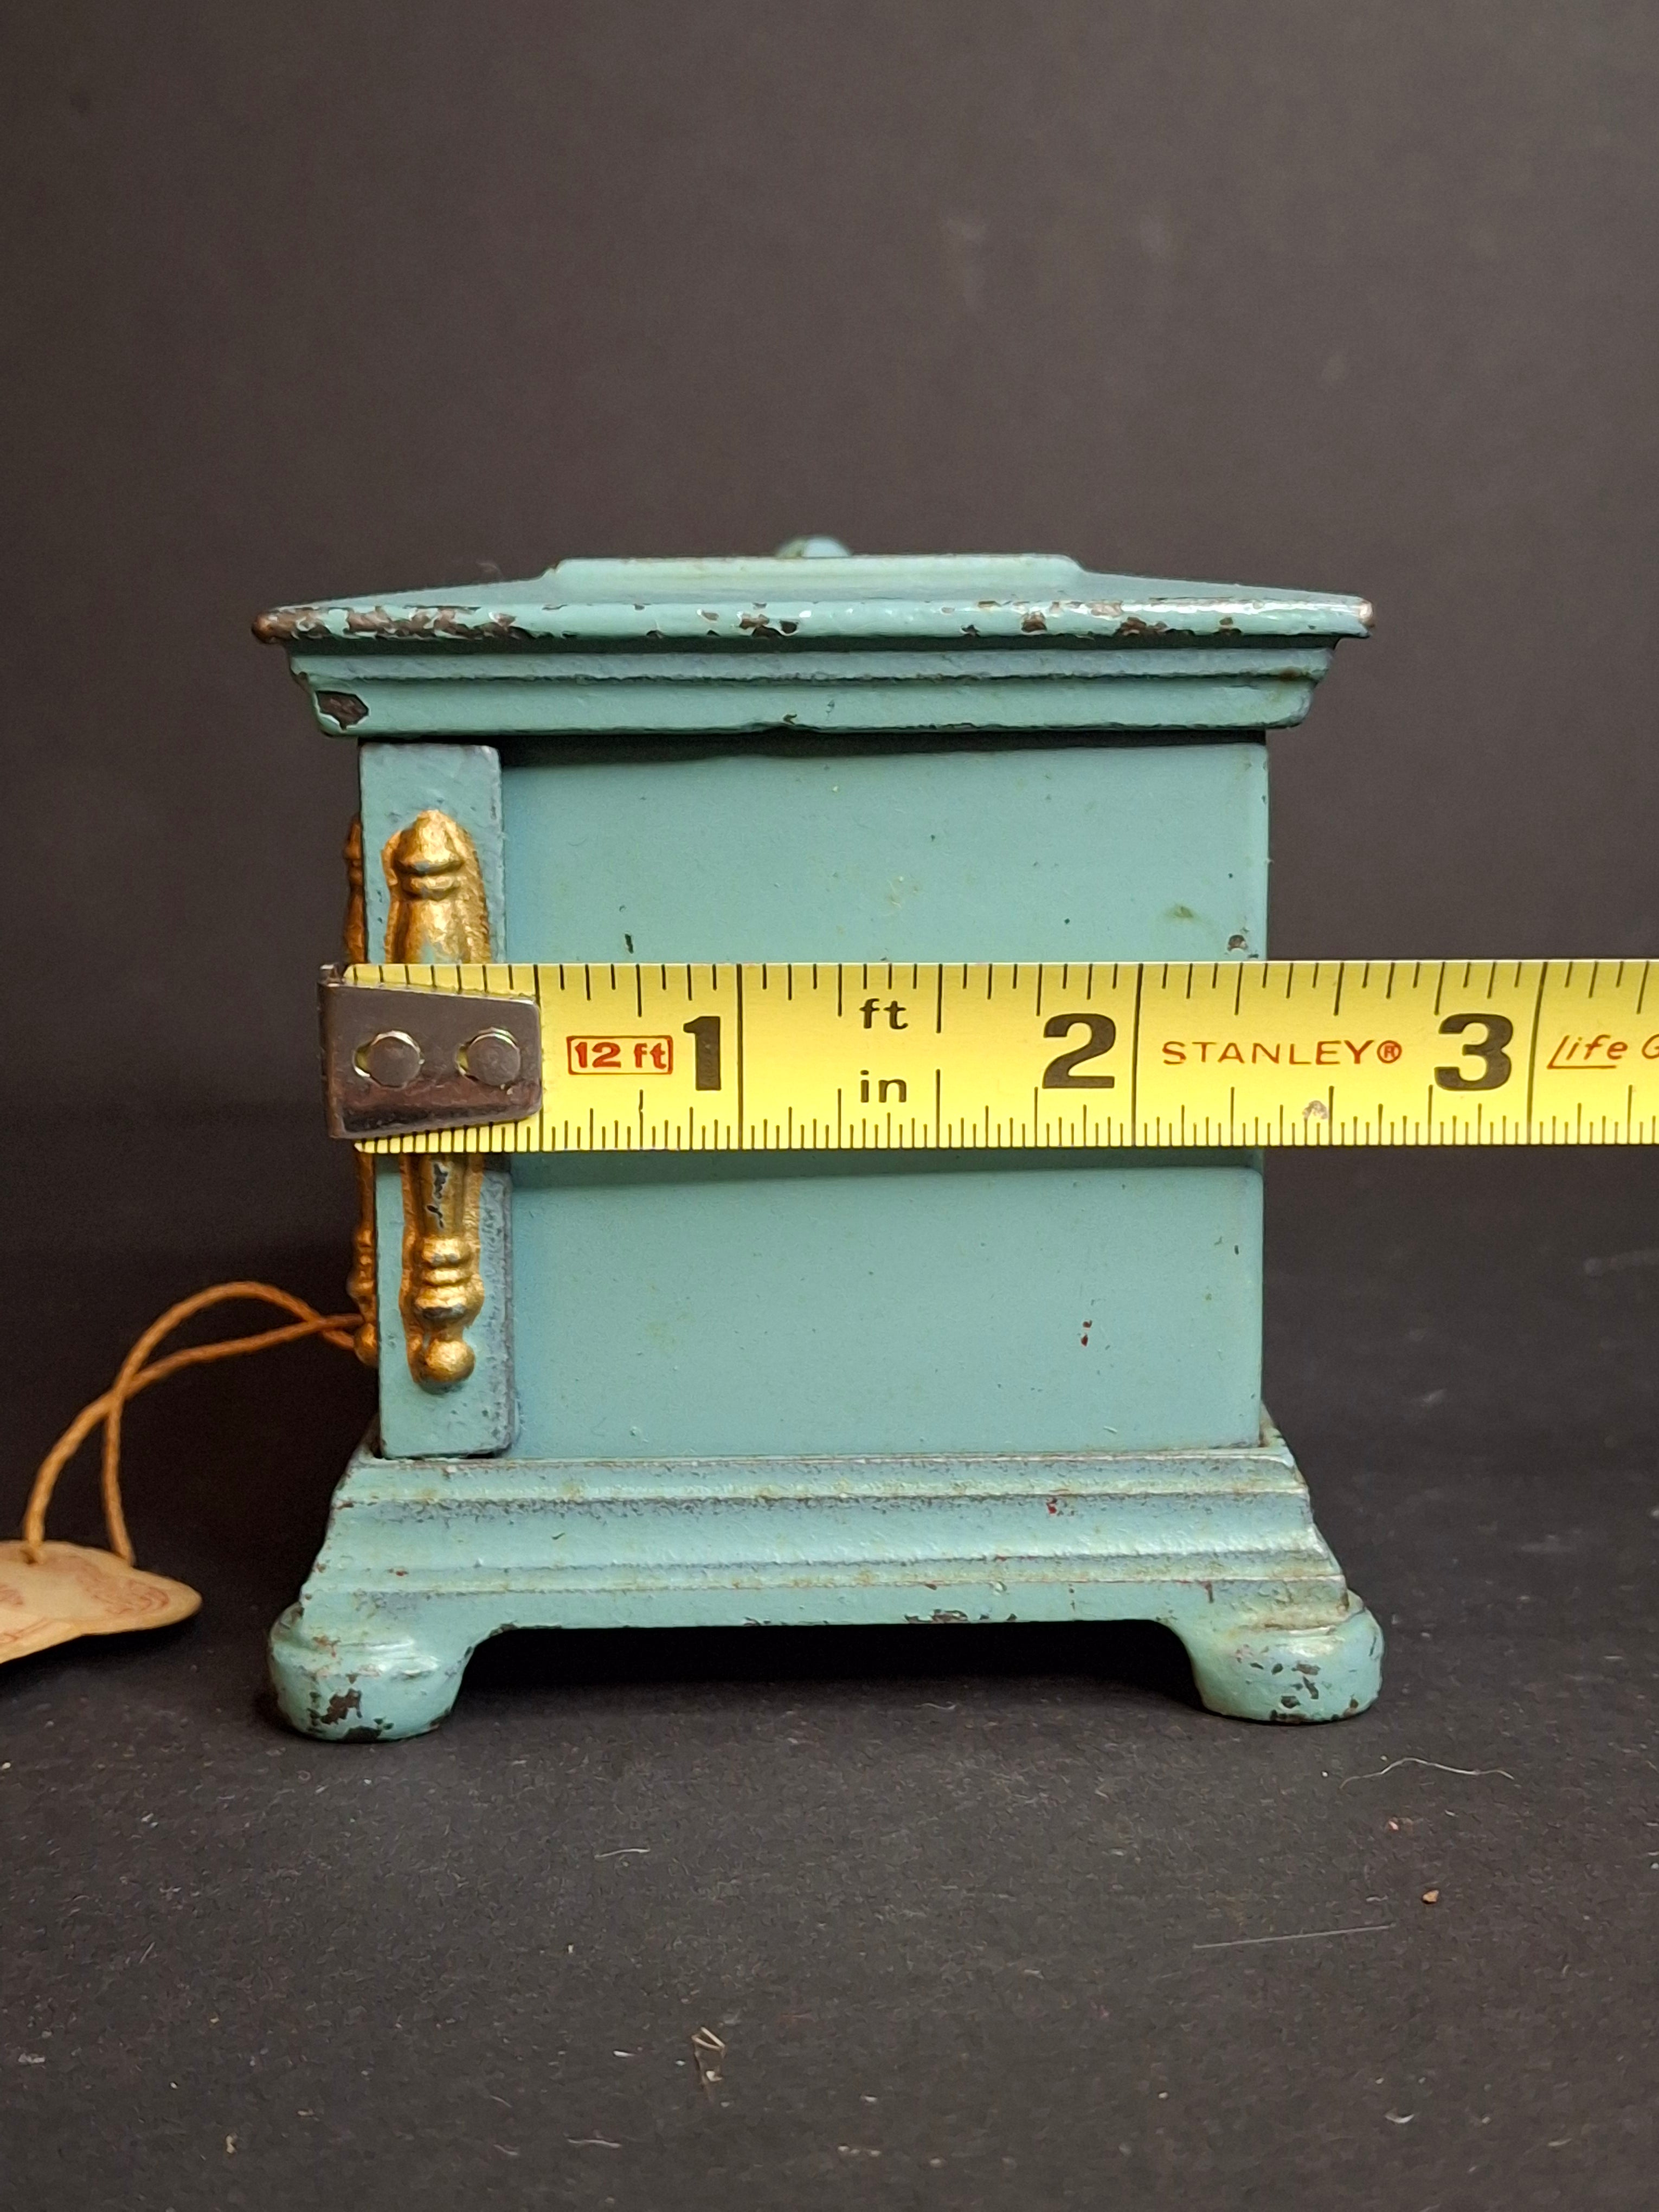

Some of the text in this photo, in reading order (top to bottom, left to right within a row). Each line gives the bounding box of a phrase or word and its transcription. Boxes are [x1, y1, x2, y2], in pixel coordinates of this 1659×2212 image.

[860, 998, 909, 1030] ft
[575, 1042, 667, 1070] 12 ft
[683, 1015, 722, 1091] 1
[1041, 1013, 1116, 1089] 2
[1434, 1013, 1514, 1091] 3
[1546, 1034, 1628, 1069] Life
[860, 1070, 907, 1103] in
